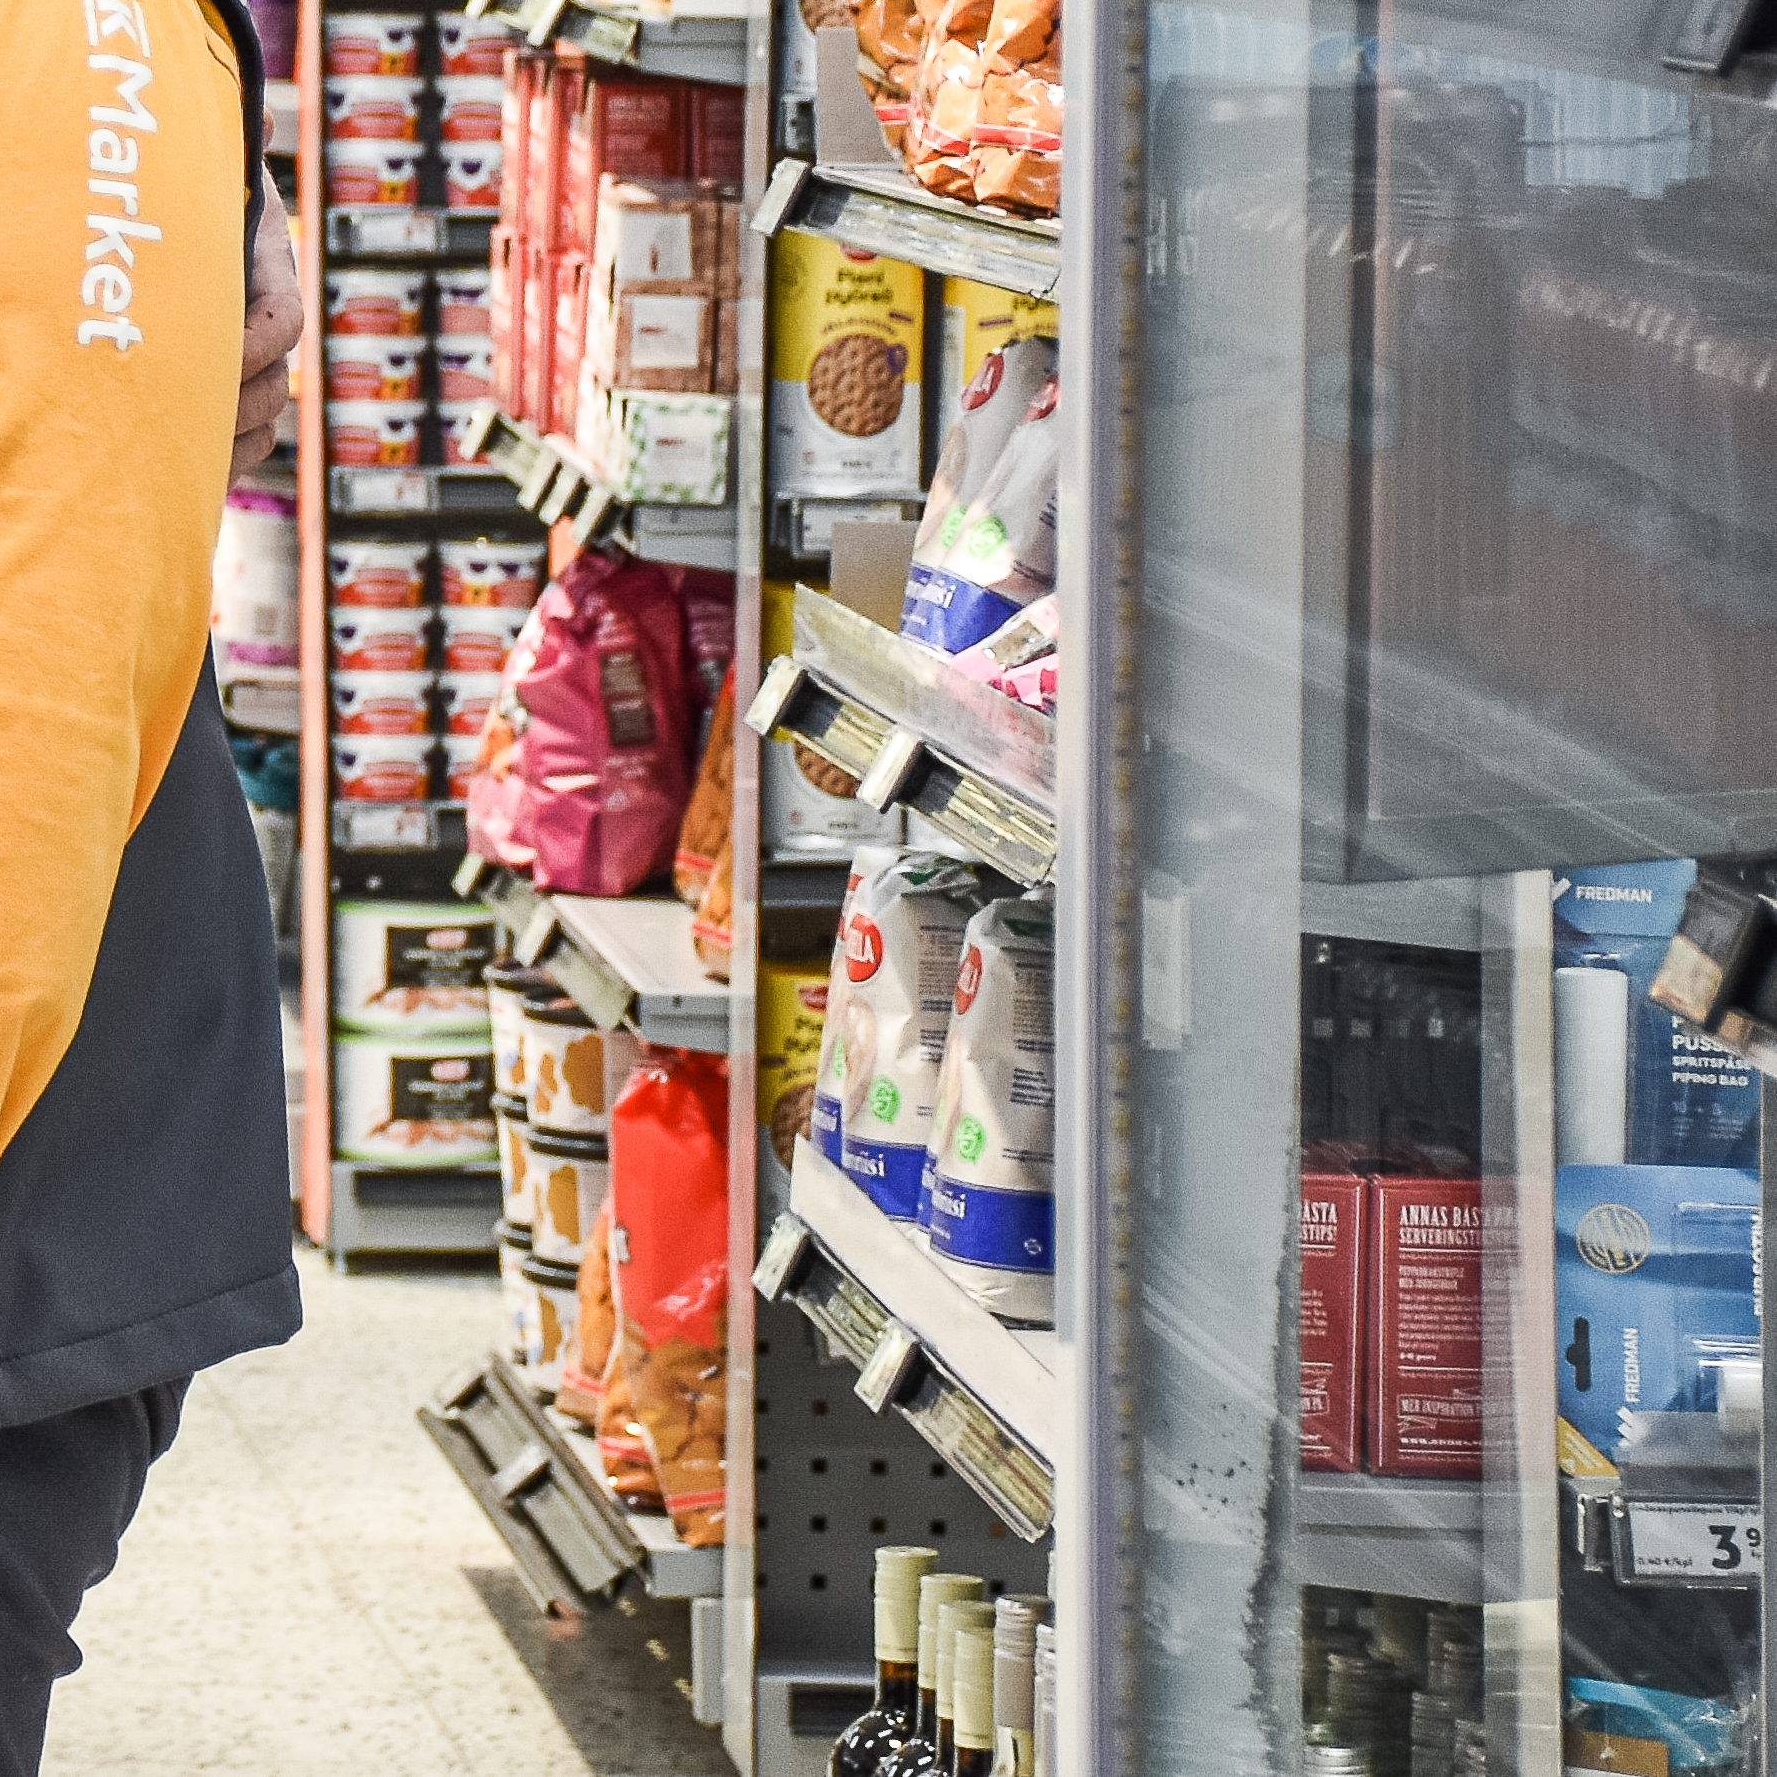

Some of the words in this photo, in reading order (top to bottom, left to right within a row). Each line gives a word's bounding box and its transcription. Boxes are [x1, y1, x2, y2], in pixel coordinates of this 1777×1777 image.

[77, 53, 164, 353] Market
[1574, 885, 1654, 904] FREDMAN
[1671, 1072, 1717, 1087] PIPING
[1718, 1073, 1749, 1088] BAG
[1399, 1204, 1449, 1226] ANNAS
[1622, 1326, 1641, 1405] FREDMAN
[1709, 1524, 1742, 1570] 3
